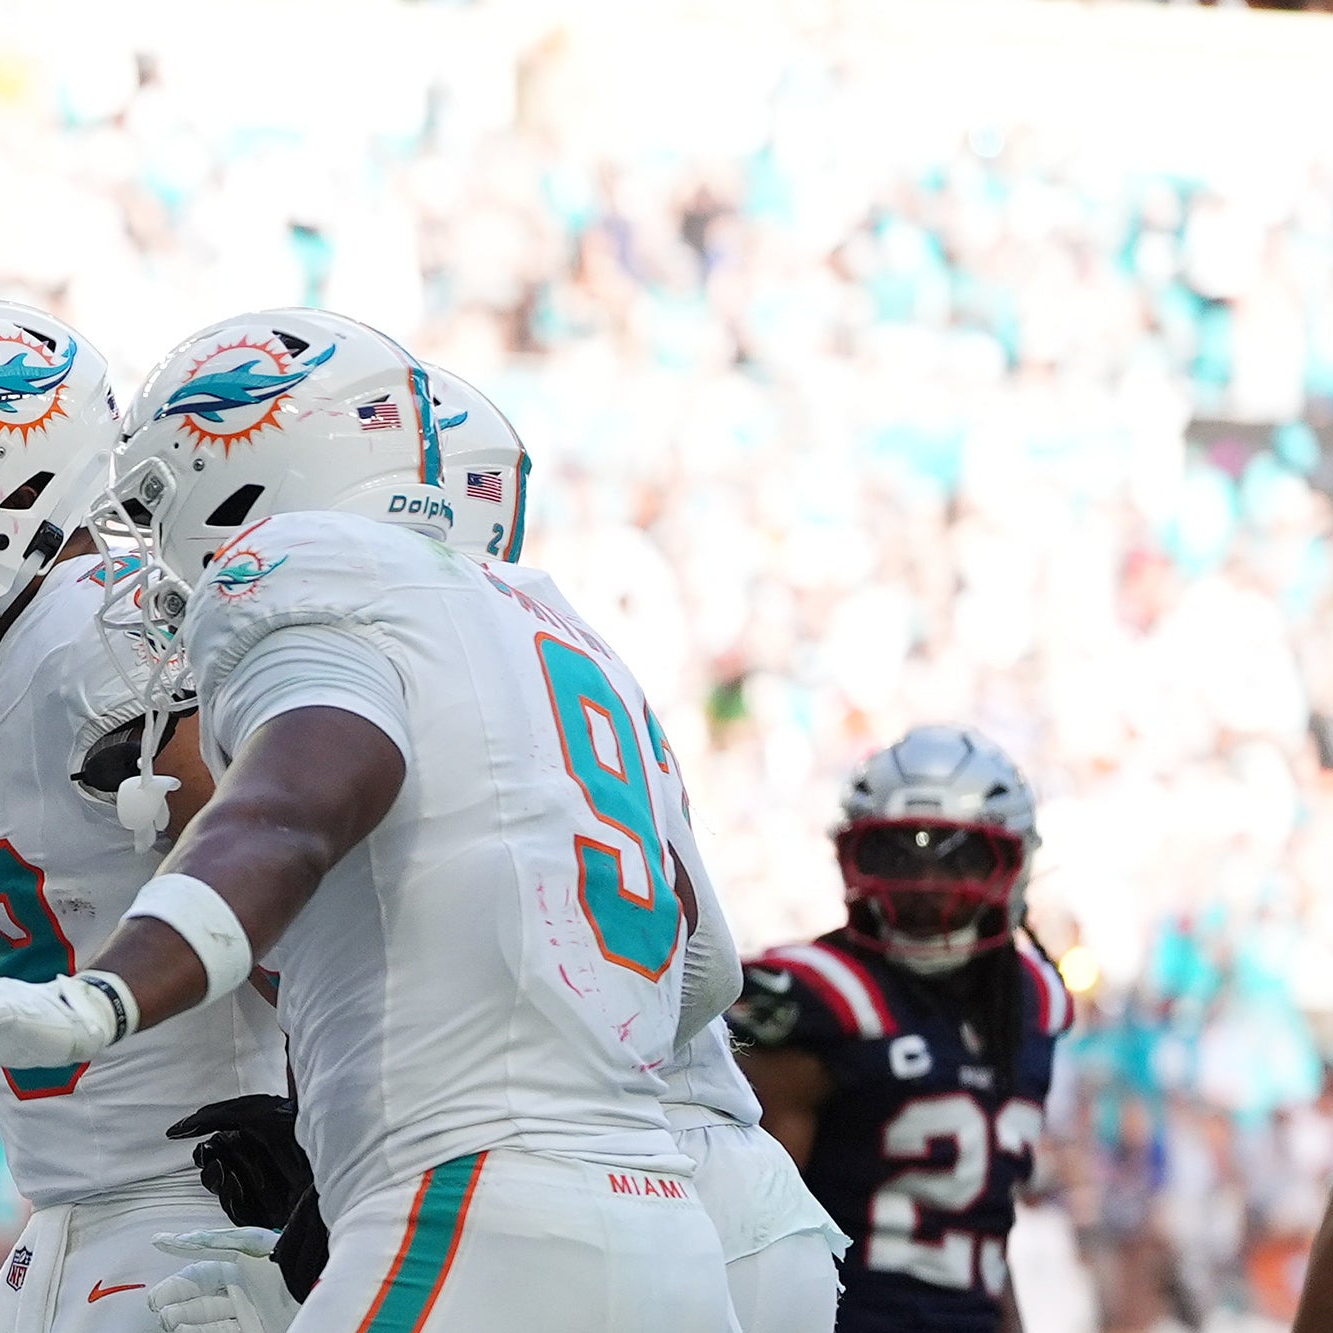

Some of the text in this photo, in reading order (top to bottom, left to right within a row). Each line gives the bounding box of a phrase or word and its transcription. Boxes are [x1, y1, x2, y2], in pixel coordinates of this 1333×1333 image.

[388, 494, 454, 529] Dolph
[486, 522, 504, 556] 2
[534, 630, 683, 983] 9
[607, 1173, 689, 1199] MIAMI
